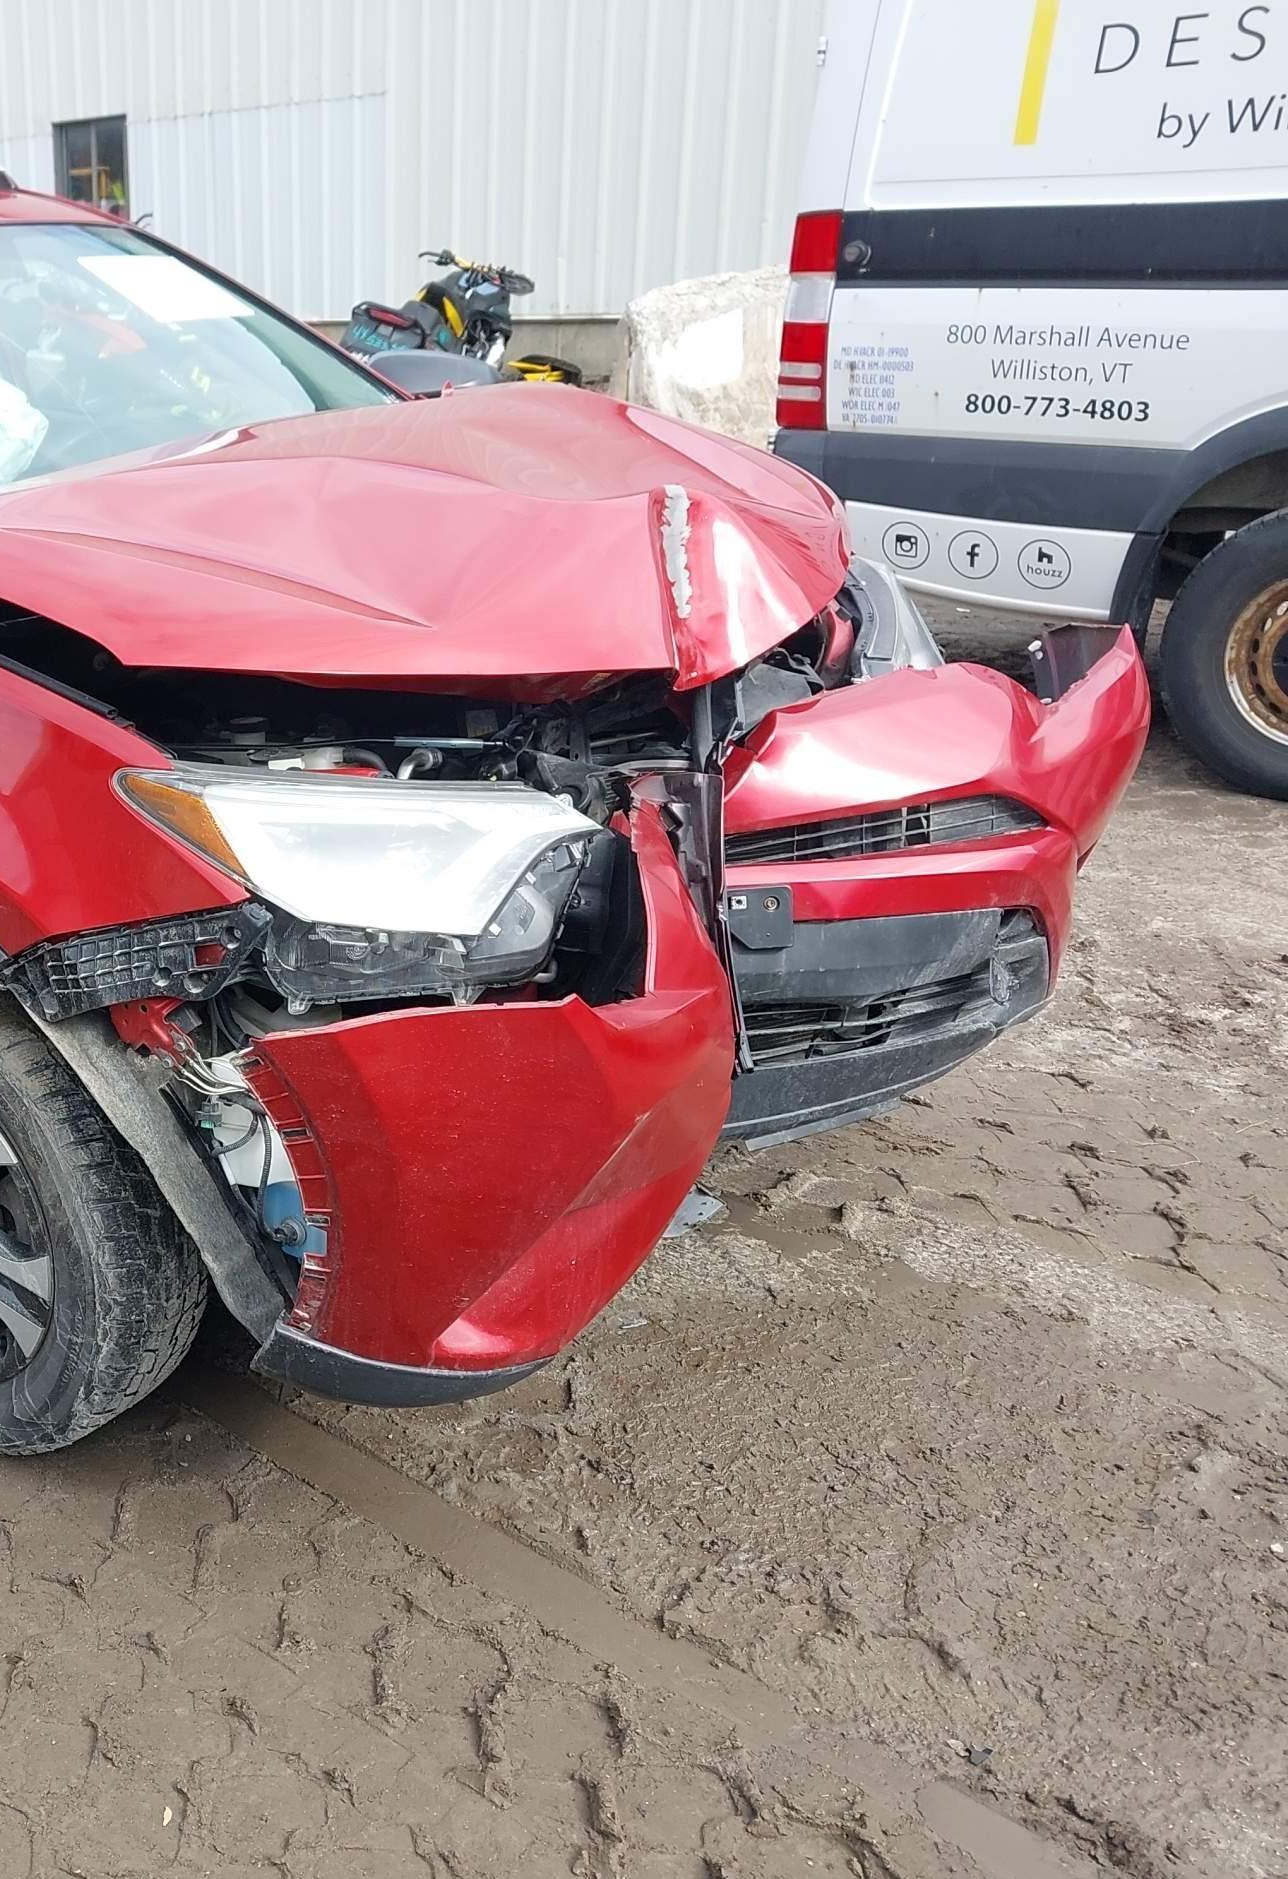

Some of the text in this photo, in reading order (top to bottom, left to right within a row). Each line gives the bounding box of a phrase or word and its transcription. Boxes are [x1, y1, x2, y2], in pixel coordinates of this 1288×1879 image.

[1156, 93, 1288, 149] by Wi
[946, 324, 1190, 351] 800 Marshall Avenue
[991, 358, 1133, 386] Williston, VT
[965, 393, 1150, 422] 800-773-4803
[1026, 563, 1064, 579] houzz
